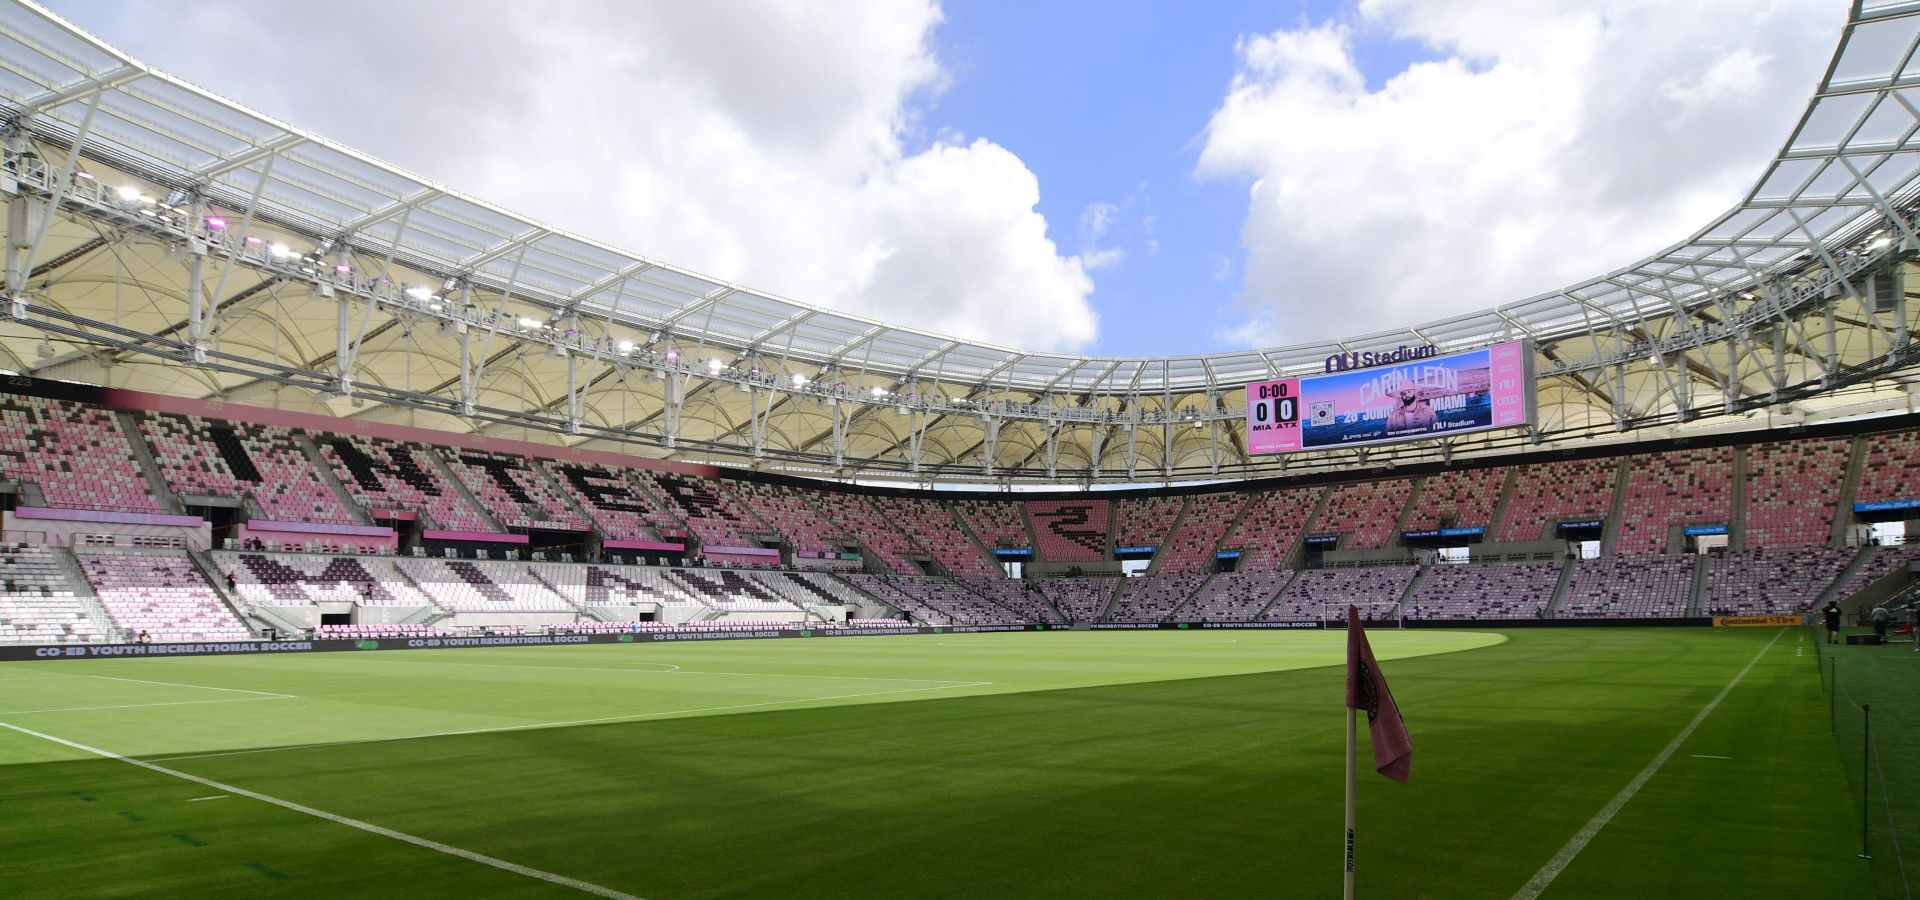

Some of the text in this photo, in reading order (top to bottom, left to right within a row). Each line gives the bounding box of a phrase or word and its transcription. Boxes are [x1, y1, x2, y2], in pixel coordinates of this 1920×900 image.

[1362, 344, 1435, 366] Stadium
[8, 377, 32, 387] 223
[1414, 363, 1458, 392] LEÓN
[1259, 383, 1288, 399] 0:00
[1430, 394, 1467, 411] MIAMI
[1256, 399, 1293, 422] 0 0
[1344, 411, 1359, 423] 28
[1252, 422, 1298, 432] MIA ATX
[1447, 419, 1475, 428] Stadium
[389, 511, 399, 519] 10
[505, 518, 530, 527] LEO
[533, 520, 571, 530] MESSI
[1720, 615, 1796, 626] Continental Tire
[408, 635, 589, 647] CO-ED YOUTH RECREATIONAL SOCCER
[703, 631, 754, 639] RECREATIONAL
[36, 642, 312, 657] CO-ED YOUTH RECREATIONAL SOCCER
